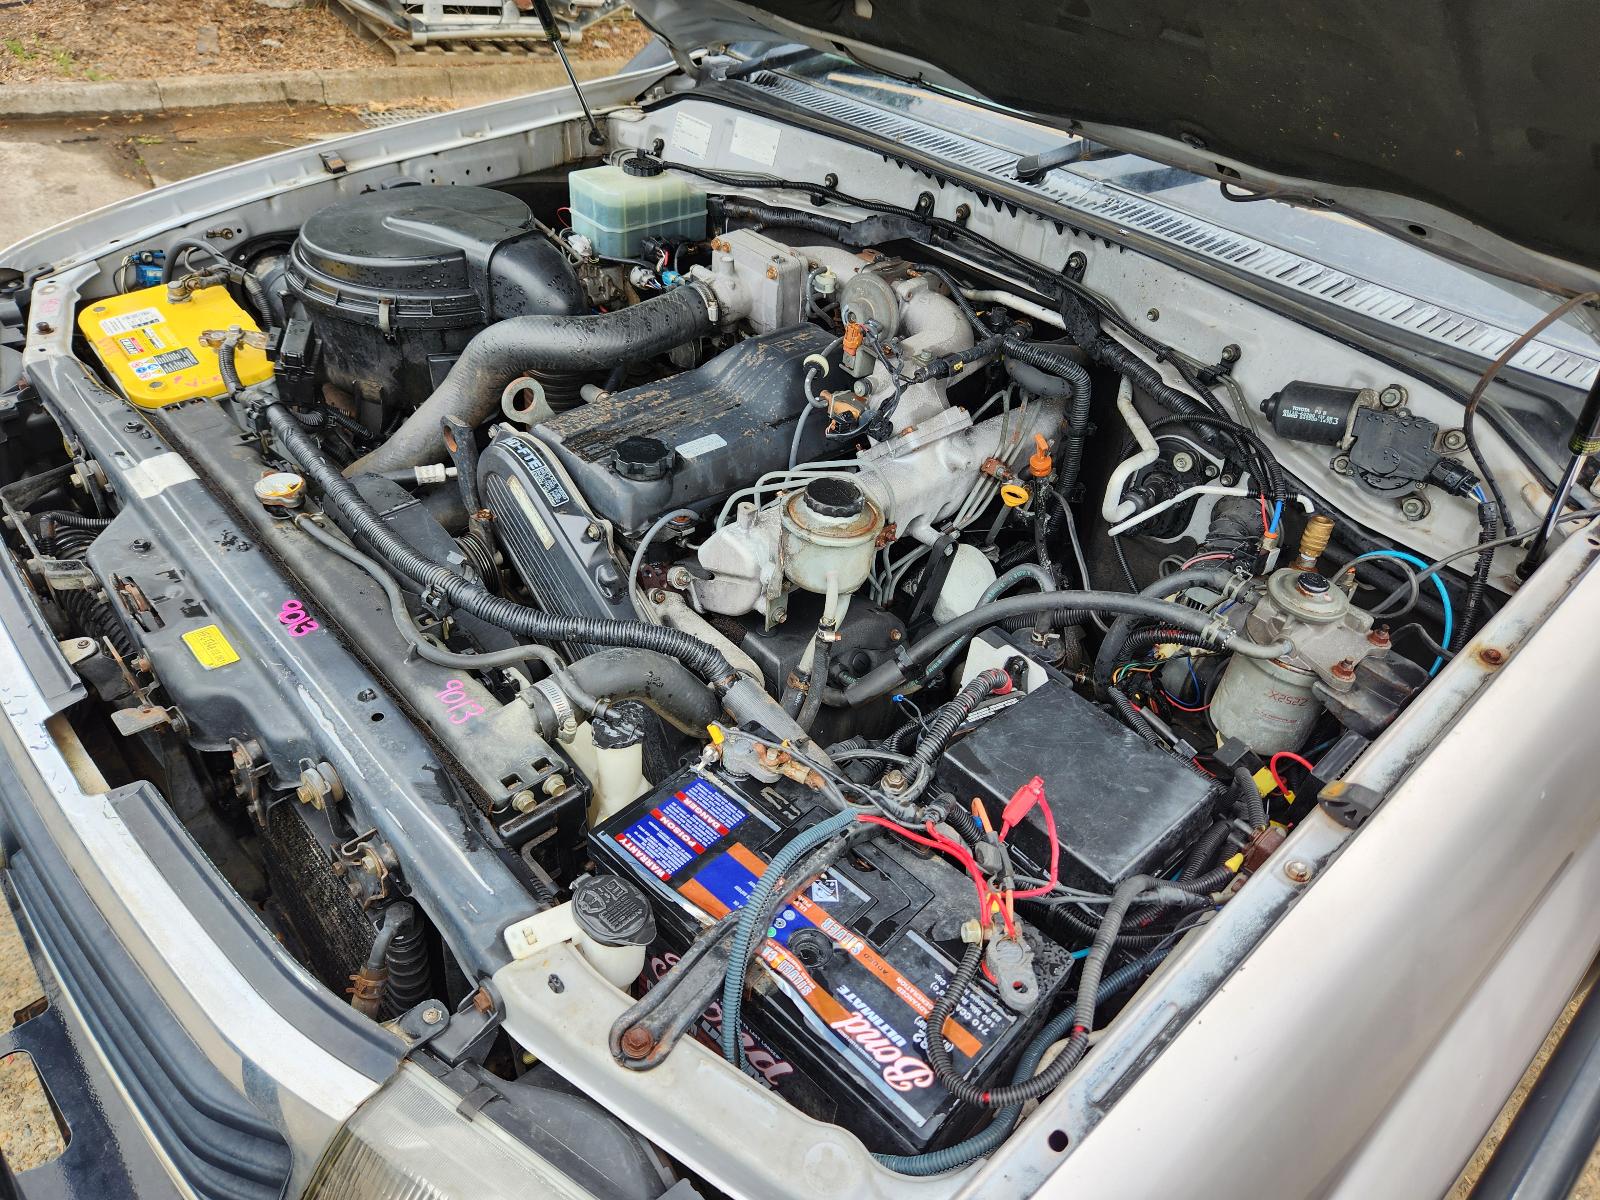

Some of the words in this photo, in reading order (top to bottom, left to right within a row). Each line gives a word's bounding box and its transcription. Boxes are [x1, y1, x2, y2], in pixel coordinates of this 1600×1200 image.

[279, 600, 320, 637] 9013
[437, 680, 484, 726] 9013
[659, 815, 697, 847] POISON
[682, 796, 721, 829] DANGER
[618, 836, 666, 877] WARRANTY
[820, 917, 864, 955] SILVER
[776, 958, 812, 996] SILVER
[895, 976, 934, 1009] GENERATION
[835, 982, 907, 1047] ULTIMATE
[896, 986, 929, 1015] ADVANCED
[970, 1017, 990, 1035] 710
[829, 1010, 933, 1092] Bond
